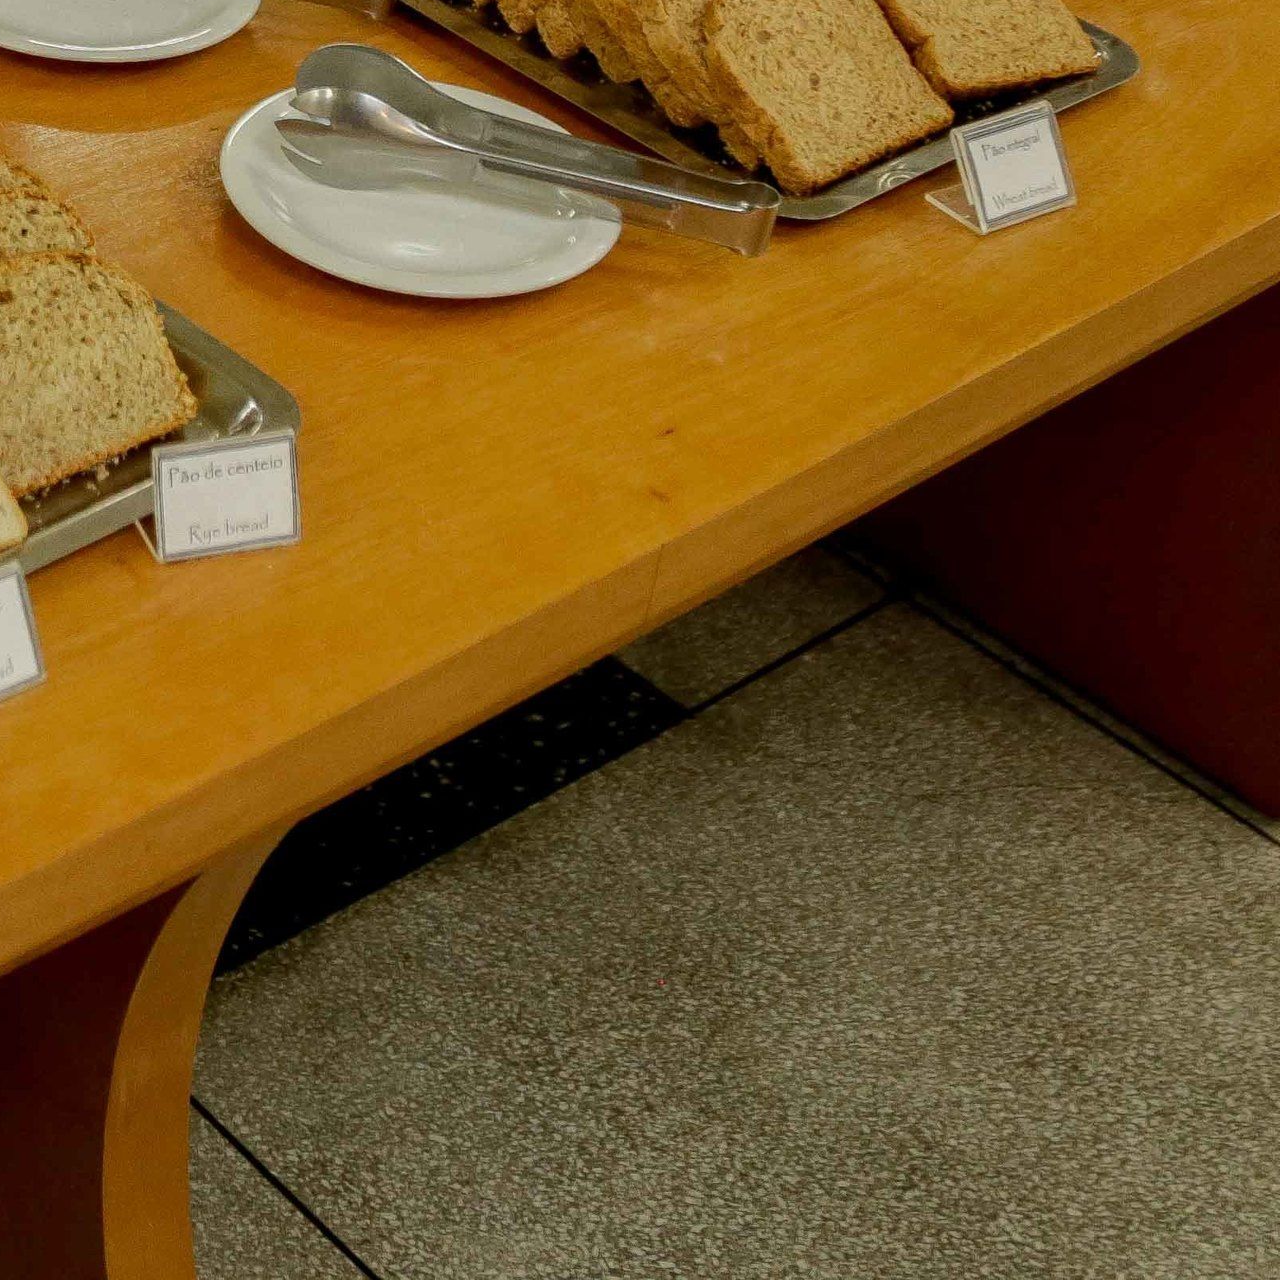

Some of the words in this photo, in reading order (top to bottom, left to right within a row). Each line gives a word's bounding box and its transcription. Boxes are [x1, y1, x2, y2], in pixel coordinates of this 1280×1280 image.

[168, 466, 201, 489] Pão
[204, 460, 225, 480] de
[226, 455, 284, 477] centeio
